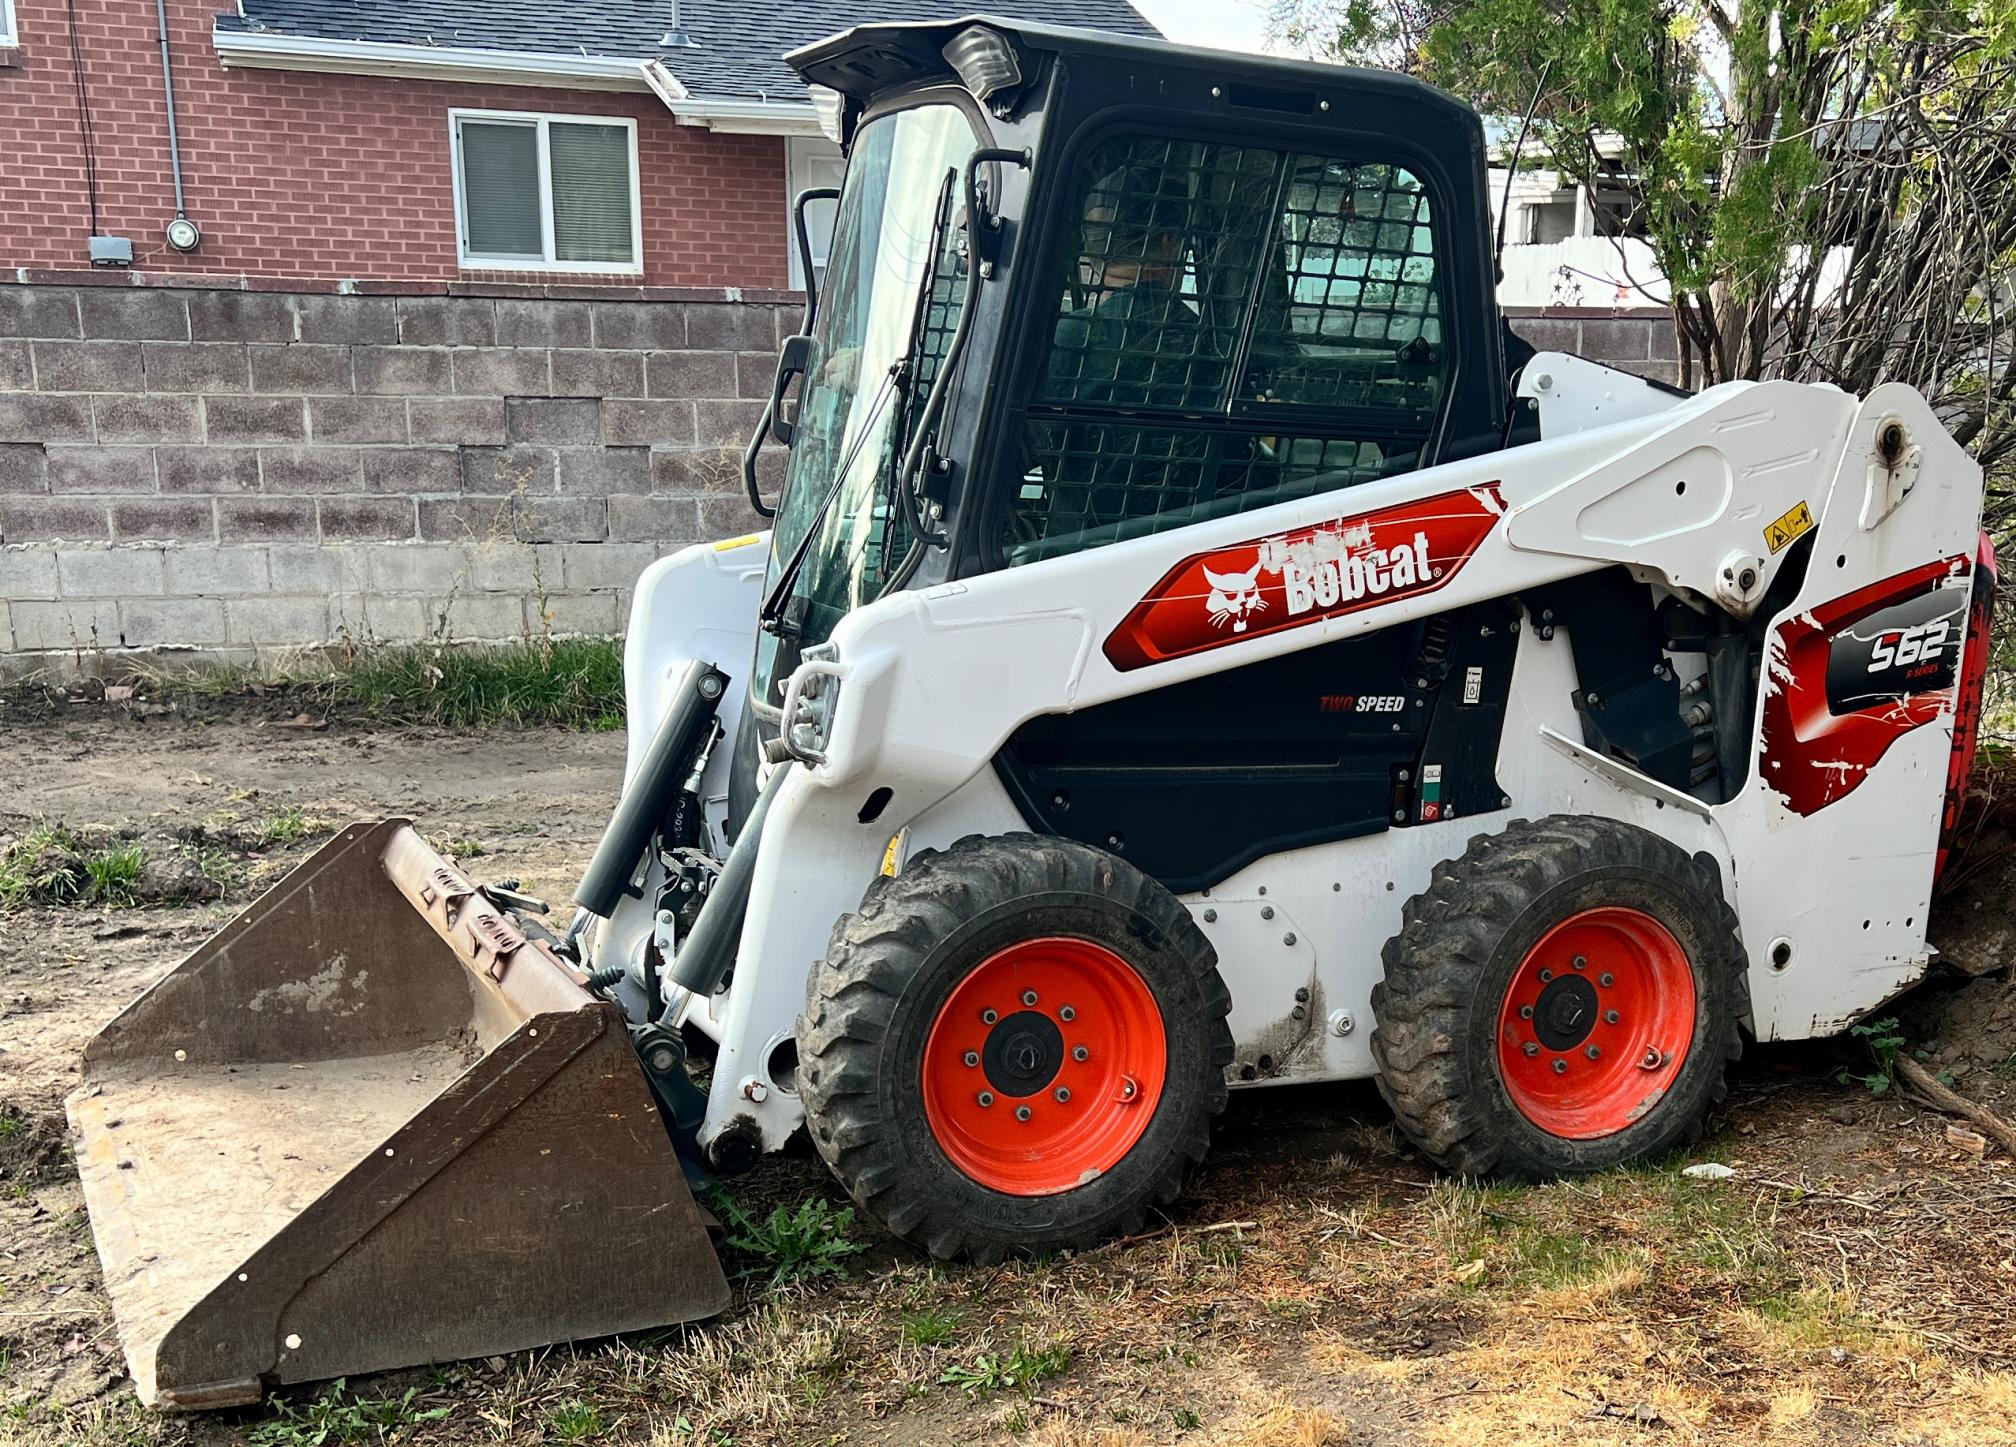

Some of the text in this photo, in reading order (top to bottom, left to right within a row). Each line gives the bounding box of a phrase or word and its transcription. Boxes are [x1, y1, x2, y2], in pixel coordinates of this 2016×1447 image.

[1867, 620, 1949, 673] S62
[1320, 696, 1405, 712] TWO SPEED
